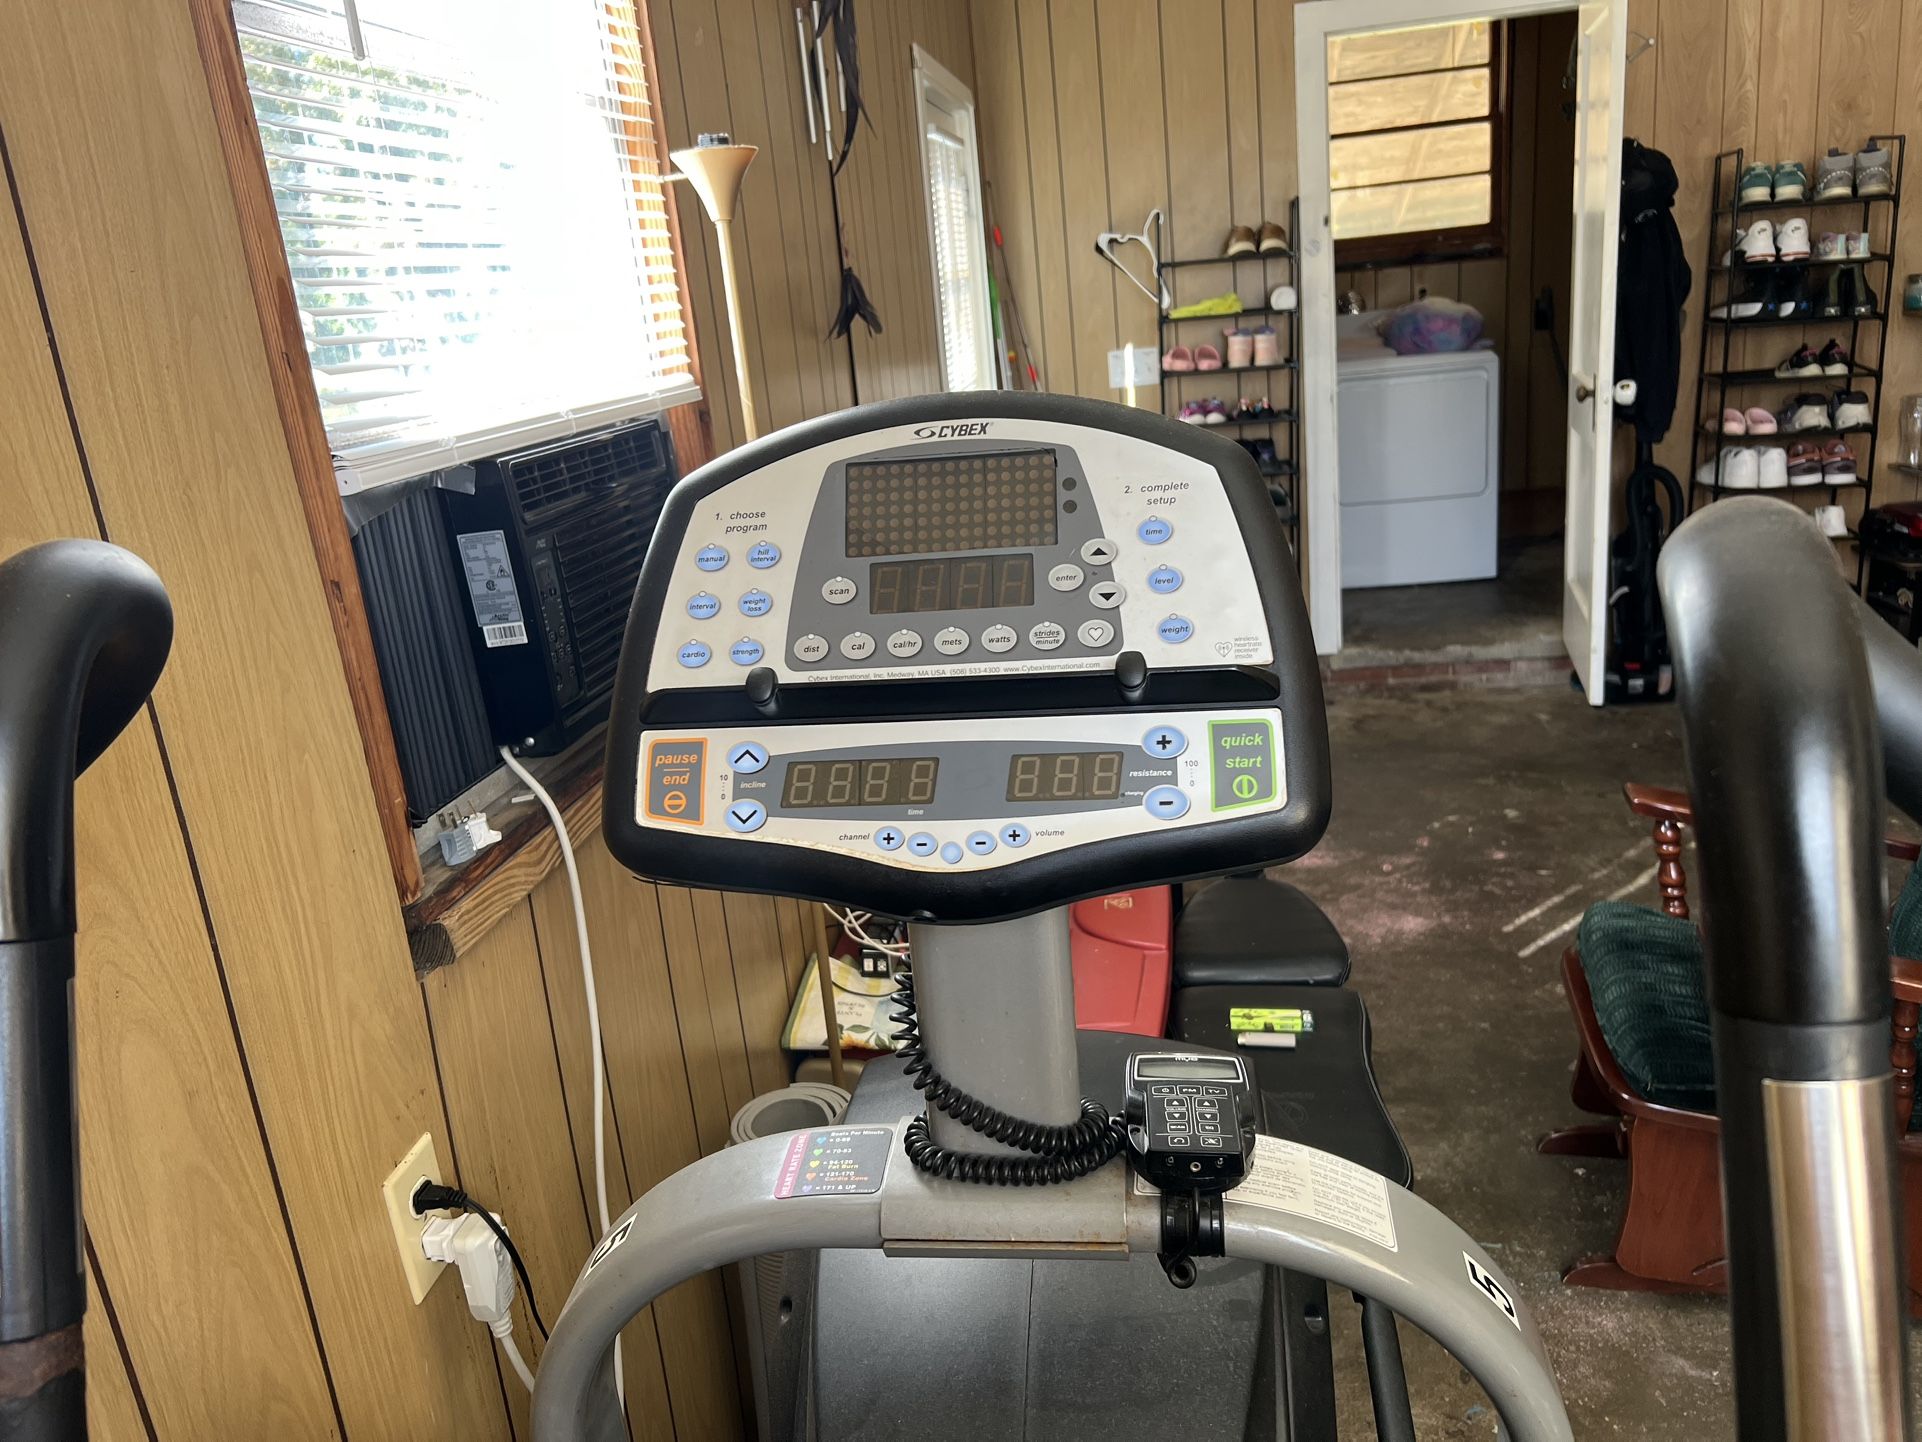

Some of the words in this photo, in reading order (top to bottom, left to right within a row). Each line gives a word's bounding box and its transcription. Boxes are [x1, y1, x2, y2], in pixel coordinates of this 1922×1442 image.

[938, 422, 989, 438] CYBEX
[1124, 485, 1133, 494] 2.
[1140, 481, 1190, 496] complete
[1146, 495, 1177, 507] setup
[715, 512, 723, 521] 1.
[729, 510, 766, 520] choose
[725, 522, 768, 535] program
[1145, 527, 1163, 535] time
[698, 555, 726, 563] manual
[750, 555, 777, 563] interval
[1055, 573, 1077, 582] enter
[1154, 575, 1174, 585] level
[828, 586, 850, 596] scan
[689, 602, 716, 611] interval
[742, 597, 767, 606] weight
[1034, 629, 1060, 638] strides
[1161, 624, 1189, 635] weight
[893, 638, 917, 649] cal/hr
[941, 637, 964, 647] mets
[988, 635, 1011, 644] watts
[1035, 637, 1061, 646] minute
[803, 644, 820, 653] dist
[851, 641, 866, 650] cal
[681, 649, 706, 659] cardio
[732, 647, 760, 657] strength
[950, 668, 966, 676] (508)
[968, 666, 1000, 675] 533-4300
[1003, 662, 1100, 673] www.CybexInternational.com
[1221, 732, 1264, 750] quick
[655, 752, 698, 768] pause
[1184, 759, 1199, 768] 100
[1225, 754, 1263, 769] start
[1129, 768, 1173, 777] resistance
[662, 772, 690, 786] end
[740, 780, 767, 789] incline
[907, 808, 924, 816] time
[838, 833, 870, 841] channel
[1035, 828, 1065, 837] volume
[1468, 1260, 1515, 1318] 5
